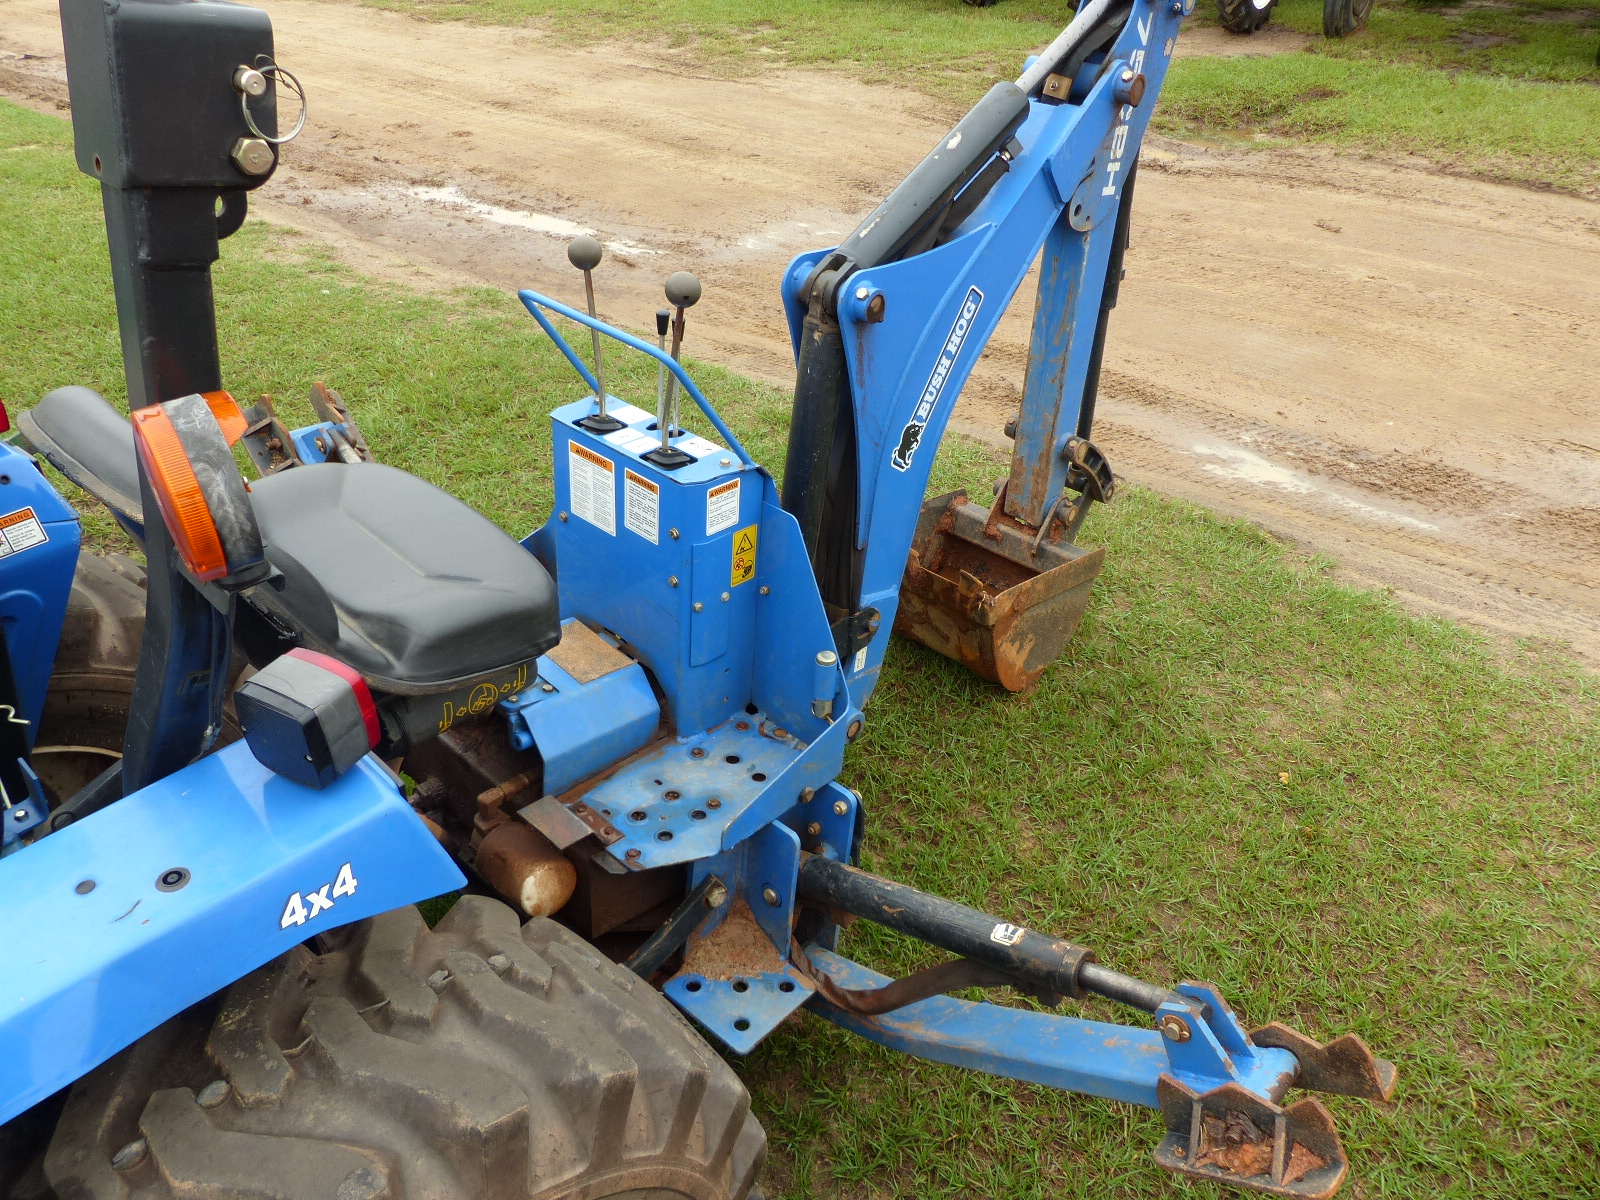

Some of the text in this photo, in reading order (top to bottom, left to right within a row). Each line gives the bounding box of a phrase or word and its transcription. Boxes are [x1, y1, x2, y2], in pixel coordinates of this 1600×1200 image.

[917, 299, 977, 420] BUSH HOG
[580, 447, 608, 468] WARNING
[633, 475, 655, 492] WARNING
[714, 482, 738, 495] WARNING
[280, 862, 358, 929] 4x4
